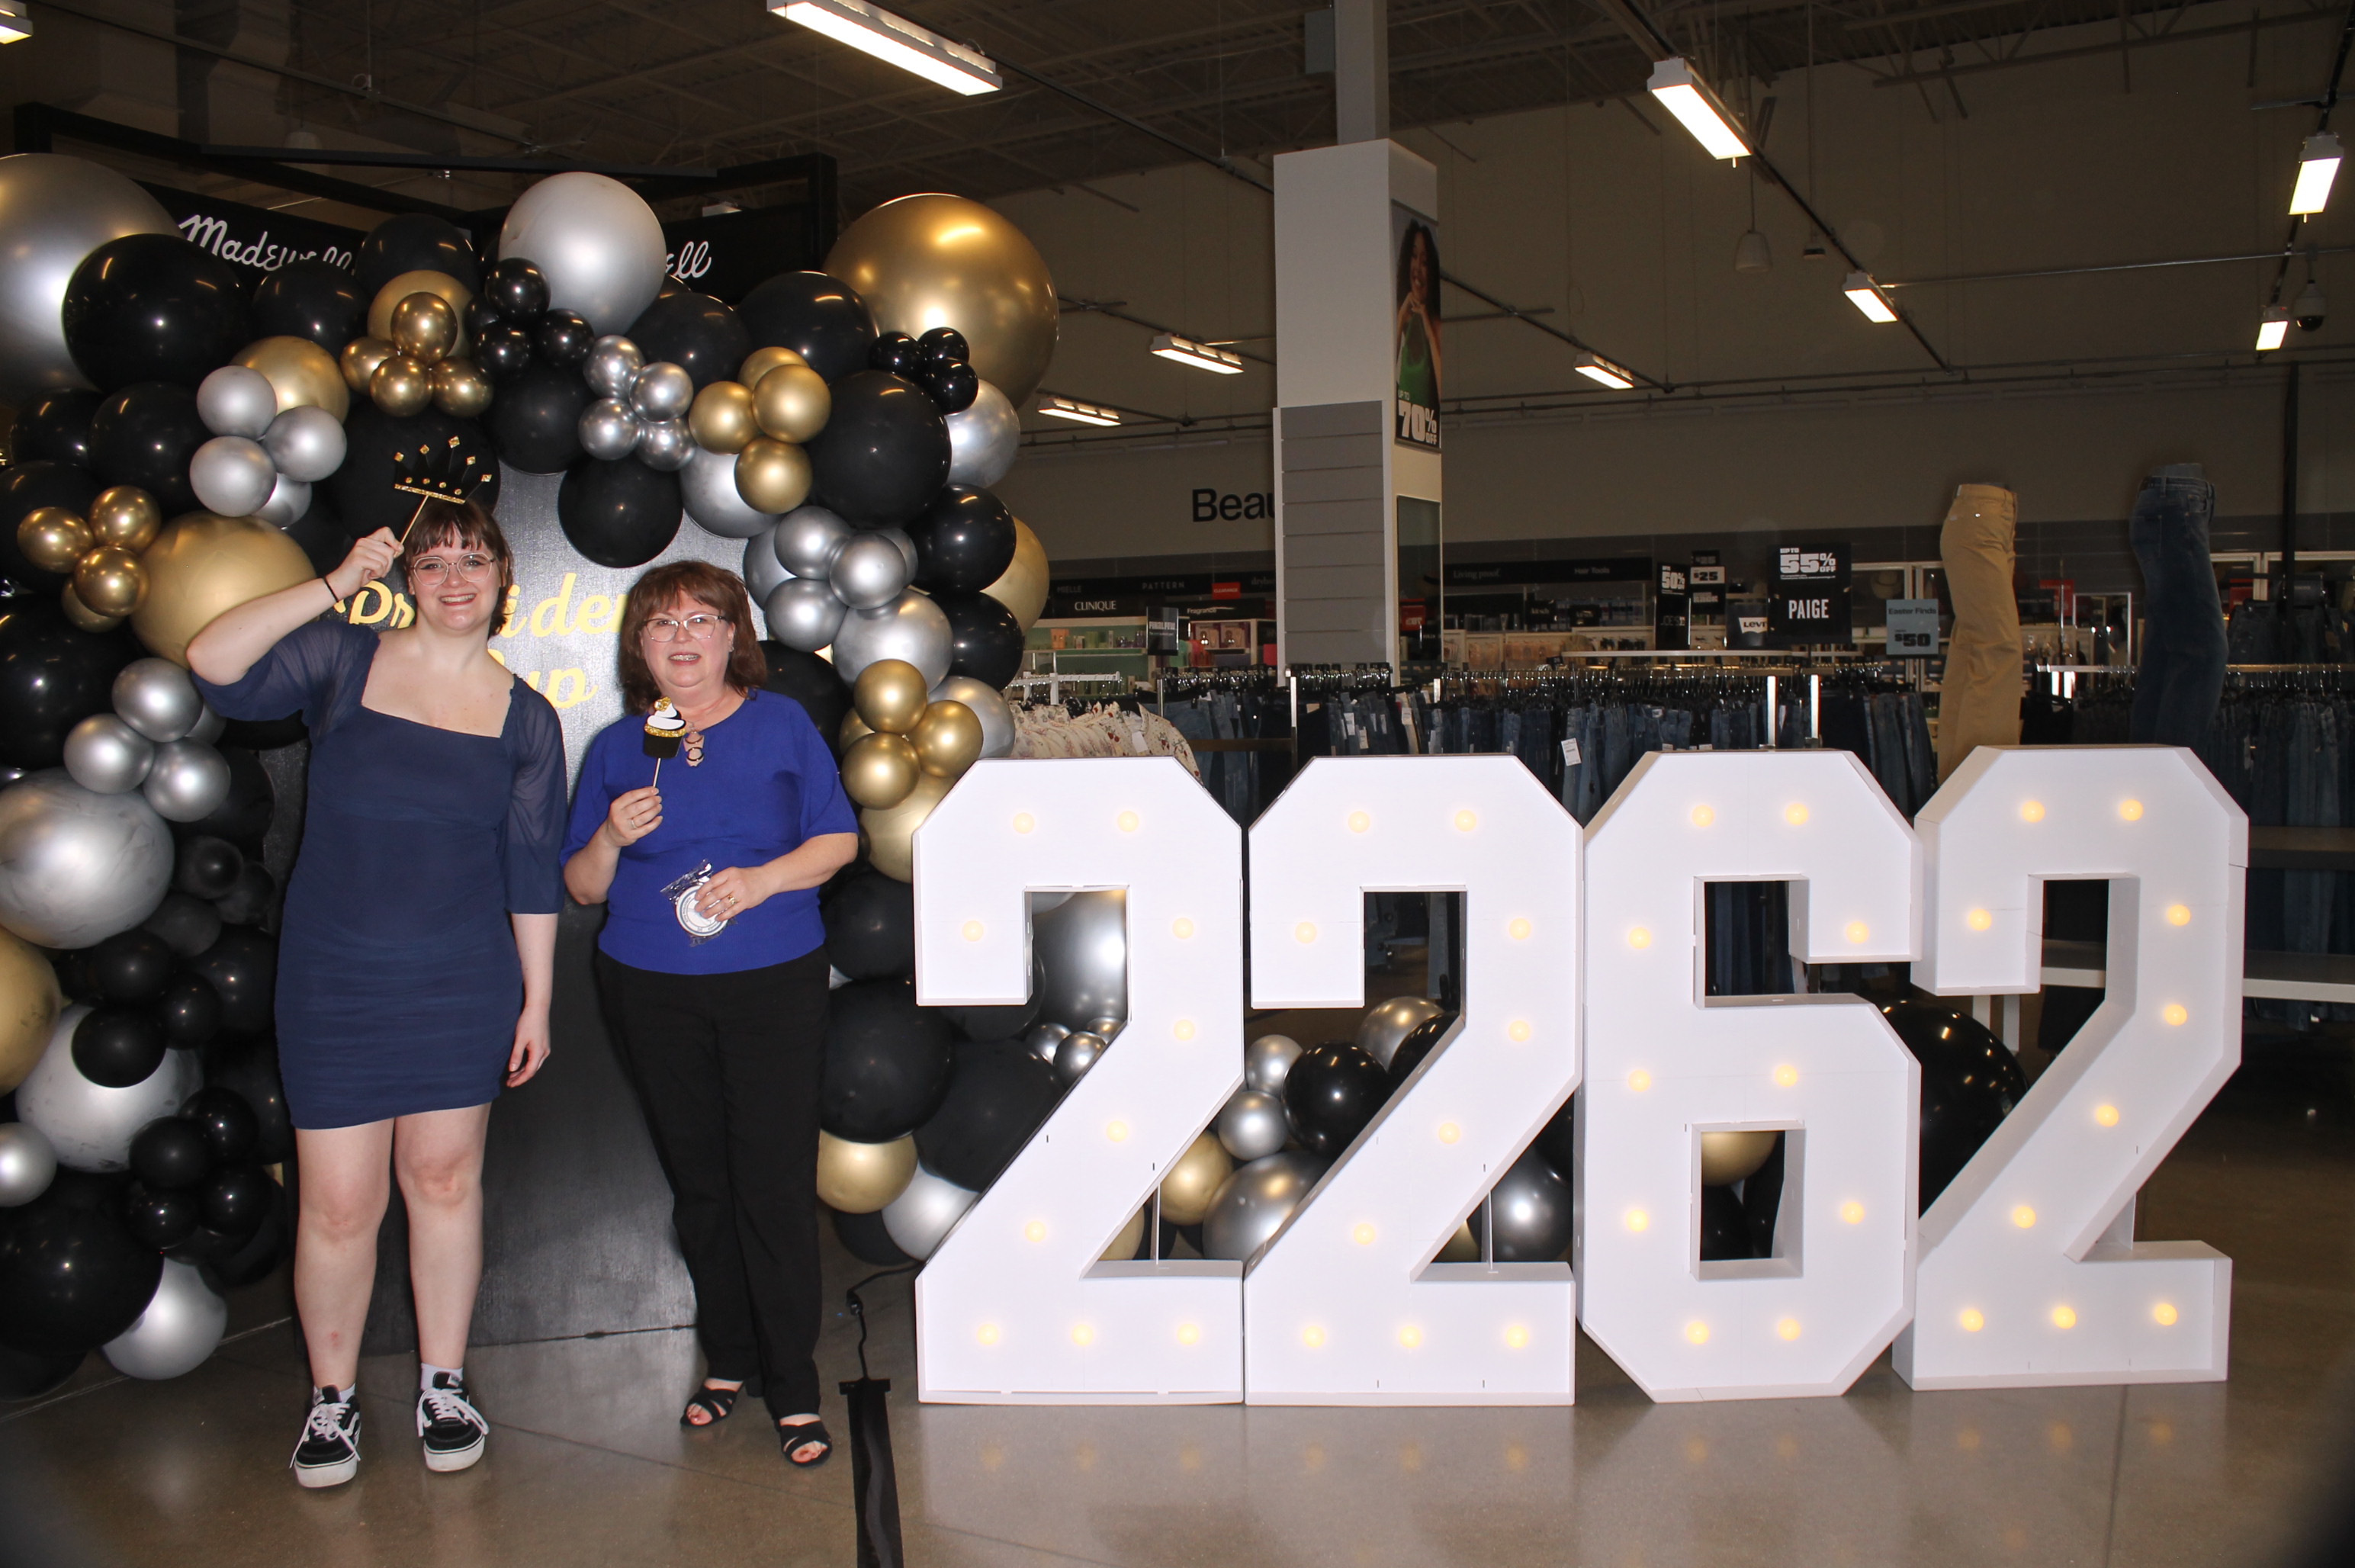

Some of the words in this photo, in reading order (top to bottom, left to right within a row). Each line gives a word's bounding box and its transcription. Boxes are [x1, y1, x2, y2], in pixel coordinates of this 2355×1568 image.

[1398, 399, 1437, 442] 70%
[1425, 432, 1438, 445] OFF
[1779, 552, 1836, 574] 55%
[1662, 571, 1685, 589] 50%
[1693, 571, 1718, 581] $25
[1141, 580, 1185, 591] PATTERN
[1074, 599, 1116, 612] CLINIQUE
[1788, 599, 1830, 619] PAIGE
[1894, 633, 1931, 647] $50
[913, 745, 2249, 1406] 2262
